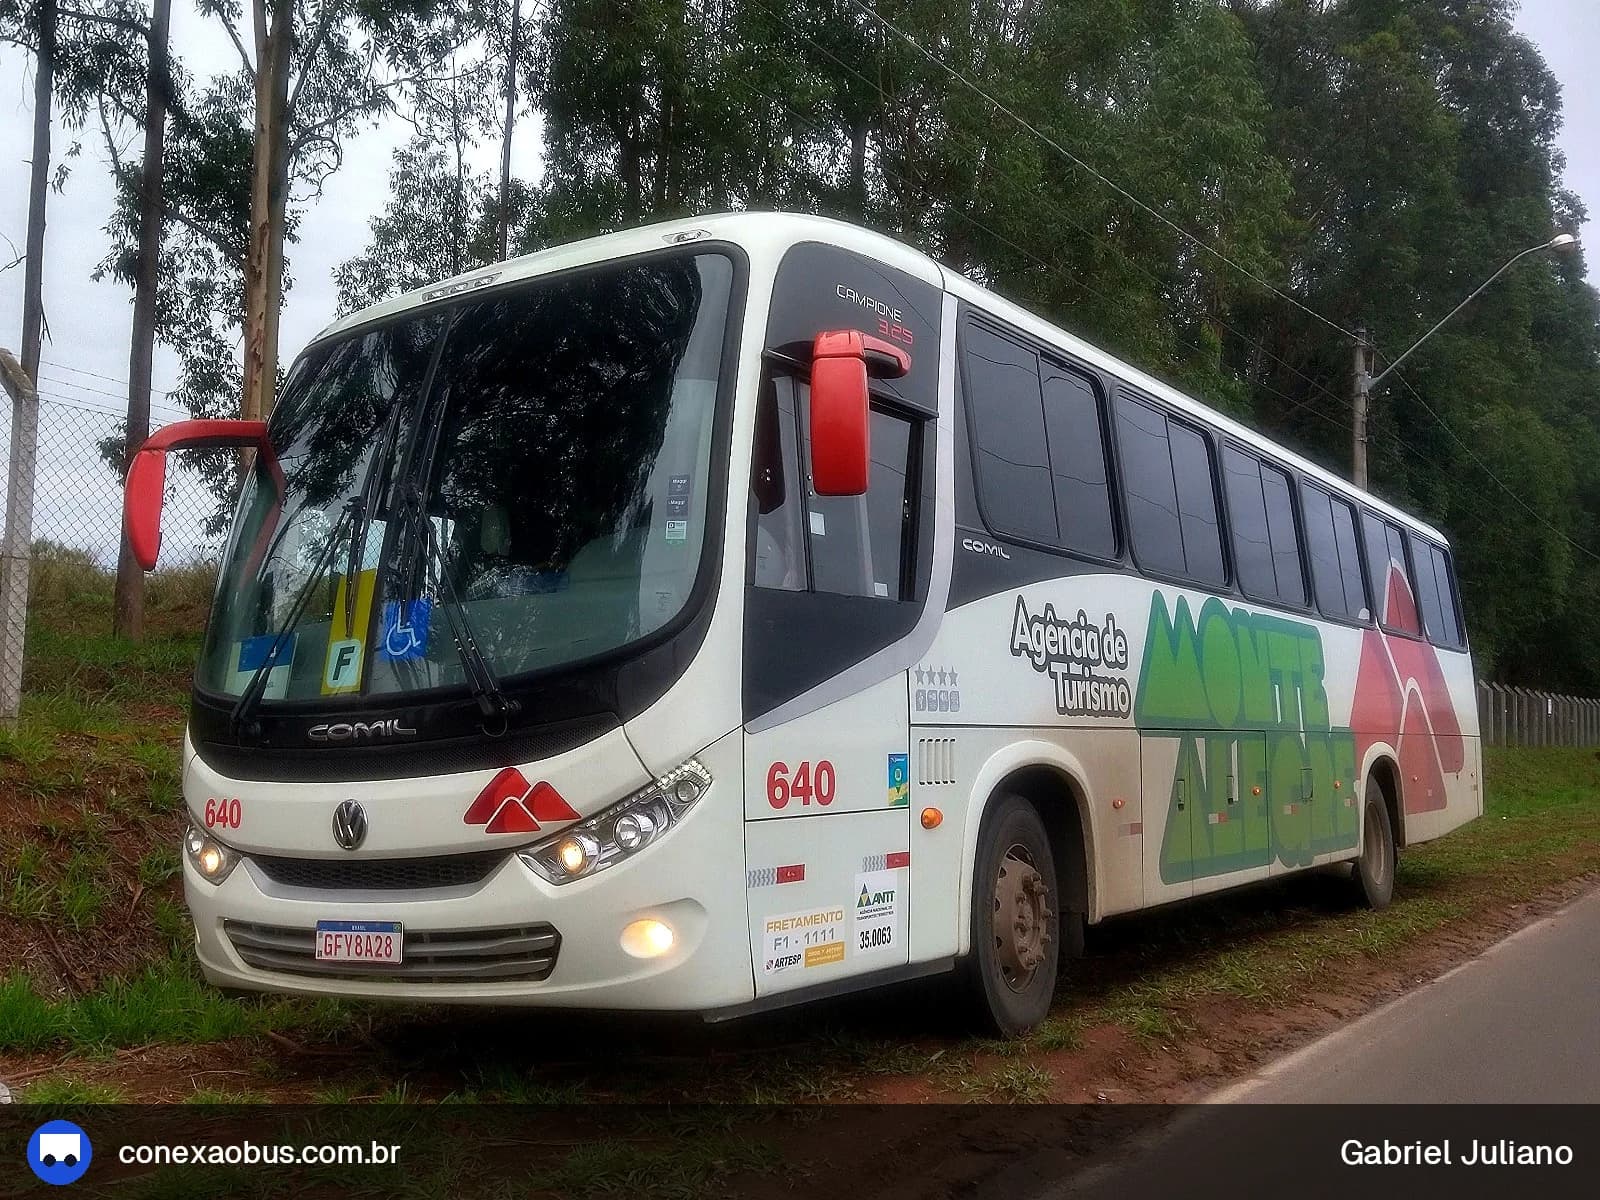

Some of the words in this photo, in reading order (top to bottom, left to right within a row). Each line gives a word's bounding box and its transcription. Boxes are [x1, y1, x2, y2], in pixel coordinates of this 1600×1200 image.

[836, 284, 902, 323] CAMPIONE
[962, 538, 1011, 560] COMIL
[1011, 596, 1101, 670] Agência
[1102, 615, 1129, 669] de
[332, 646, 355, 681] F
[1134, 589, 1329, 730] MONTE
[1049, 662, 1131, 718] Turismo
[307, 719, 417, 742] COMIL
[766, 760, 836, 810] 640
[204, 798, 242, 829] 640
[872, 890, 896, 906] ANTT
[766, 910, 843, 933] FRETAMENTO
[323, 933, 393, 959] GFY8A28
[774, 935, 790, 951] F1
[804, 927, 836, 945] 1111
[859, 926, 892, 950] 35.0063
[774, 953, 802, 969] ARTESP
